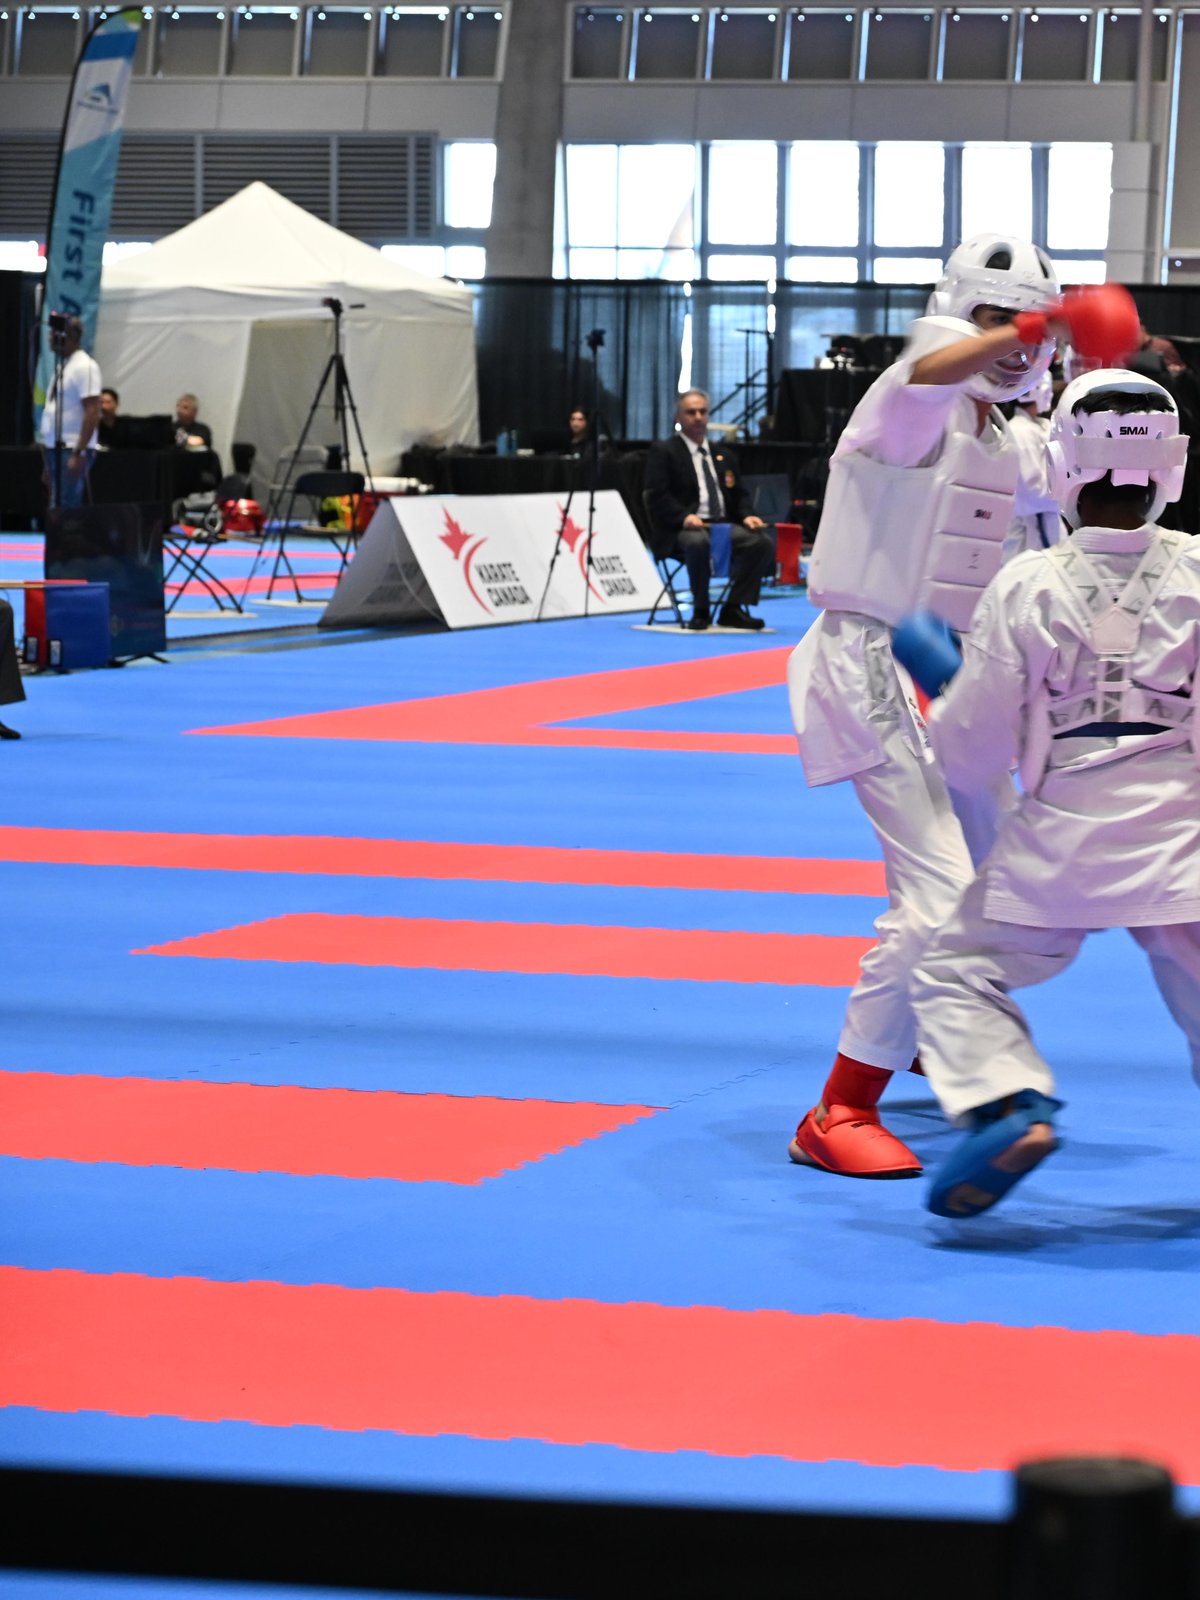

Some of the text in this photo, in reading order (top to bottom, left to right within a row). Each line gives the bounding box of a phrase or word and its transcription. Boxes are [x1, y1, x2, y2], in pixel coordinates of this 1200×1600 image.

[61, 188, 95, 283] First
[1119, 426, 1148, 436] SMAI
[474, 562, 520, 584] KARATE
[486, 585, 533, 607] CANADA
[600, 577, 637, 597] CANADA
